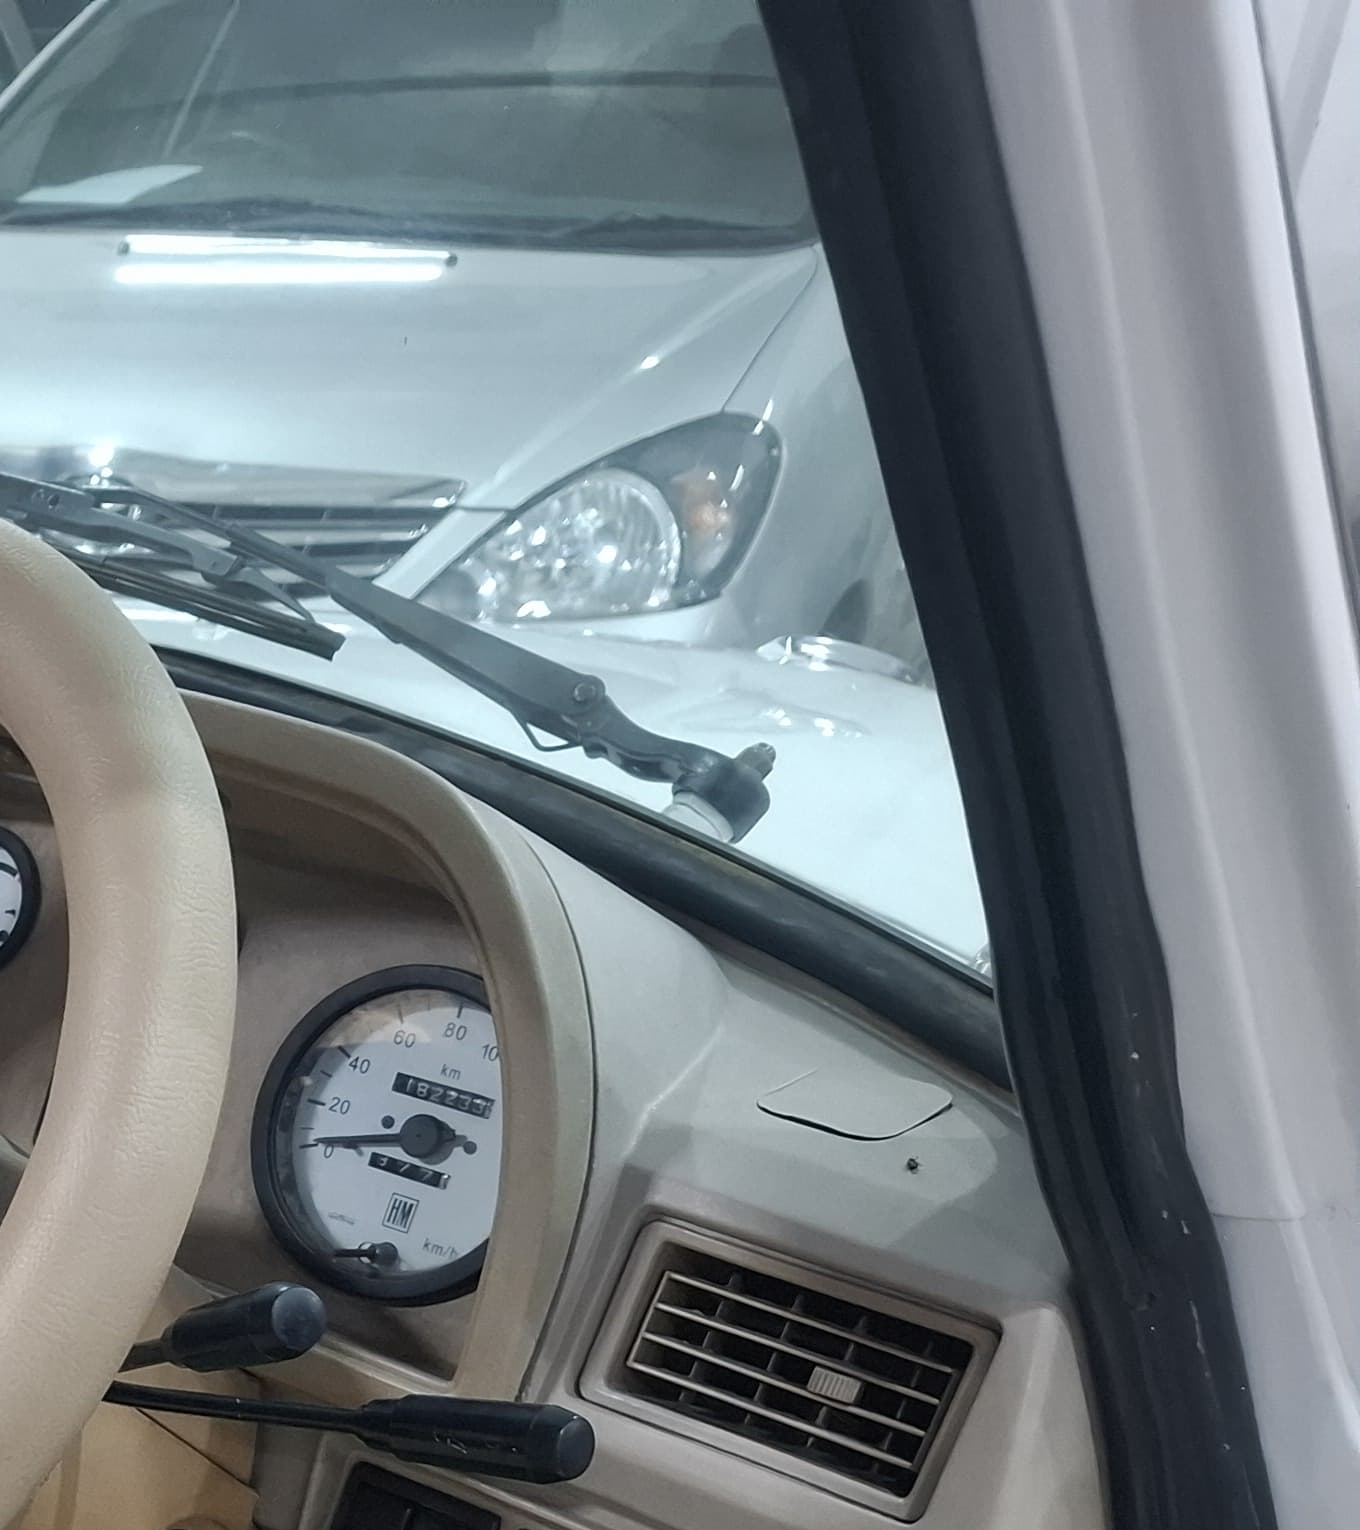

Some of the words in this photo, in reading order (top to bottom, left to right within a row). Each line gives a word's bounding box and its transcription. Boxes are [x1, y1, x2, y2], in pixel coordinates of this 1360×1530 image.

[393, 1030, 417, 1049] 60
[444, 1022, 468, 1041] 80
[481, 1043, 499, 1062] 10
[348, 1055, 371, 1075] 40
[440, 1063, 462, 1081] km
[328, 1096, 351, 1115] 20
